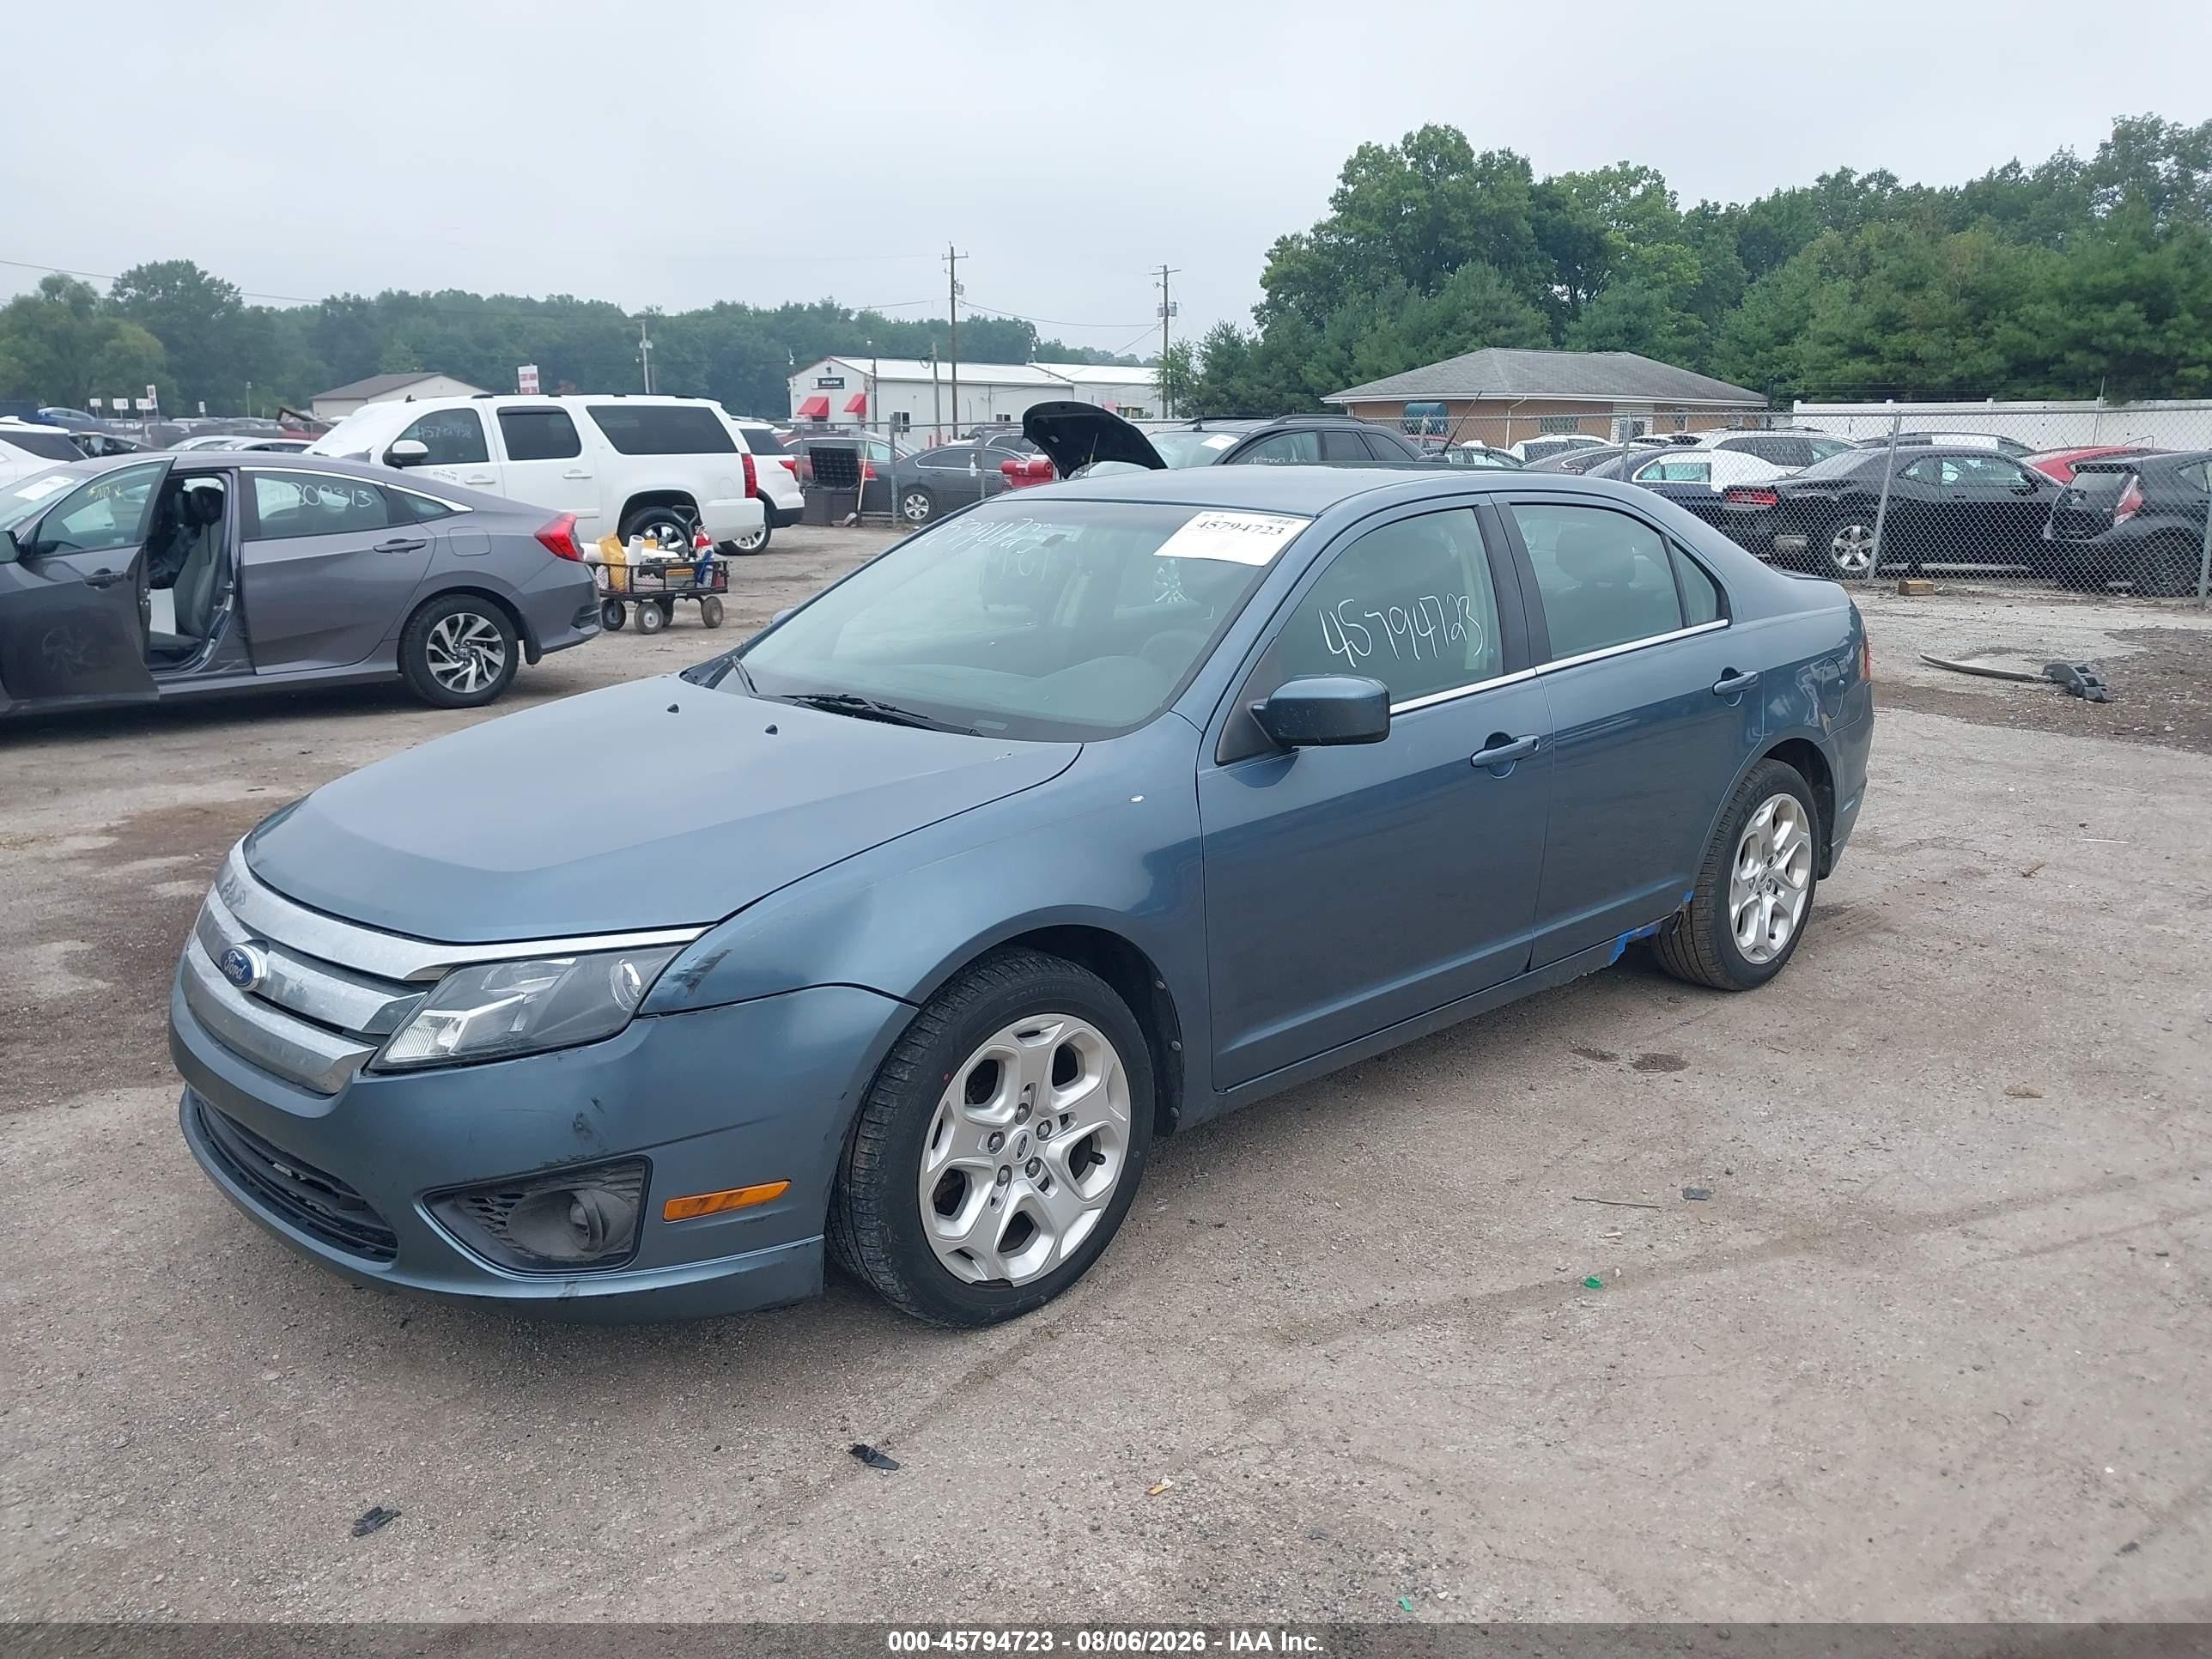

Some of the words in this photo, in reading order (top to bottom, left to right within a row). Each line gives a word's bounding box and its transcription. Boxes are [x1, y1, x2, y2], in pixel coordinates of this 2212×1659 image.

[1196, 520, 1285, 536] 45794723
[1318, 592, 1484, 668] 45794723
[223, 950, 248, 981] Ford
